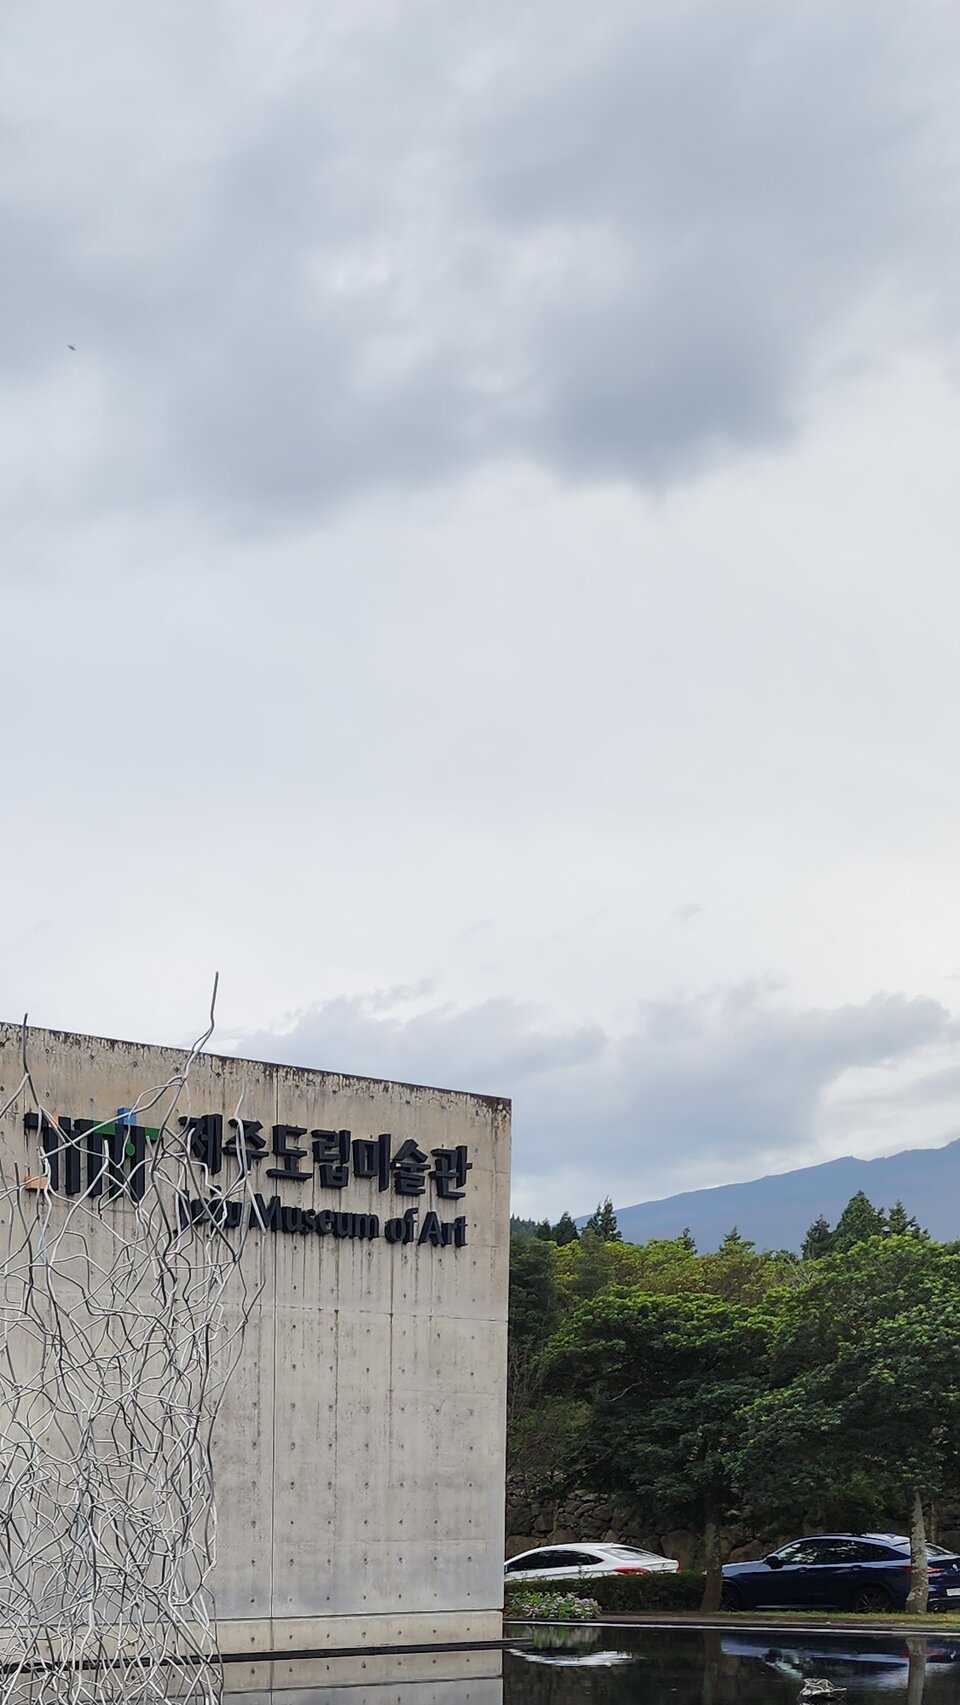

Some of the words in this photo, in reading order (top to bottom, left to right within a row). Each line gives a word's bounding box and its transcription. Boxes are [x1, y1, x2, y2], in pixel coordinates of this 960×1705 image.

[177, 1113, 472, 1200] 제주도립미술관
[249, 1193, 380, 1241] Museum
[384, 1207, 419, 1244] of
[418, 1210, 469, 1248] Art
